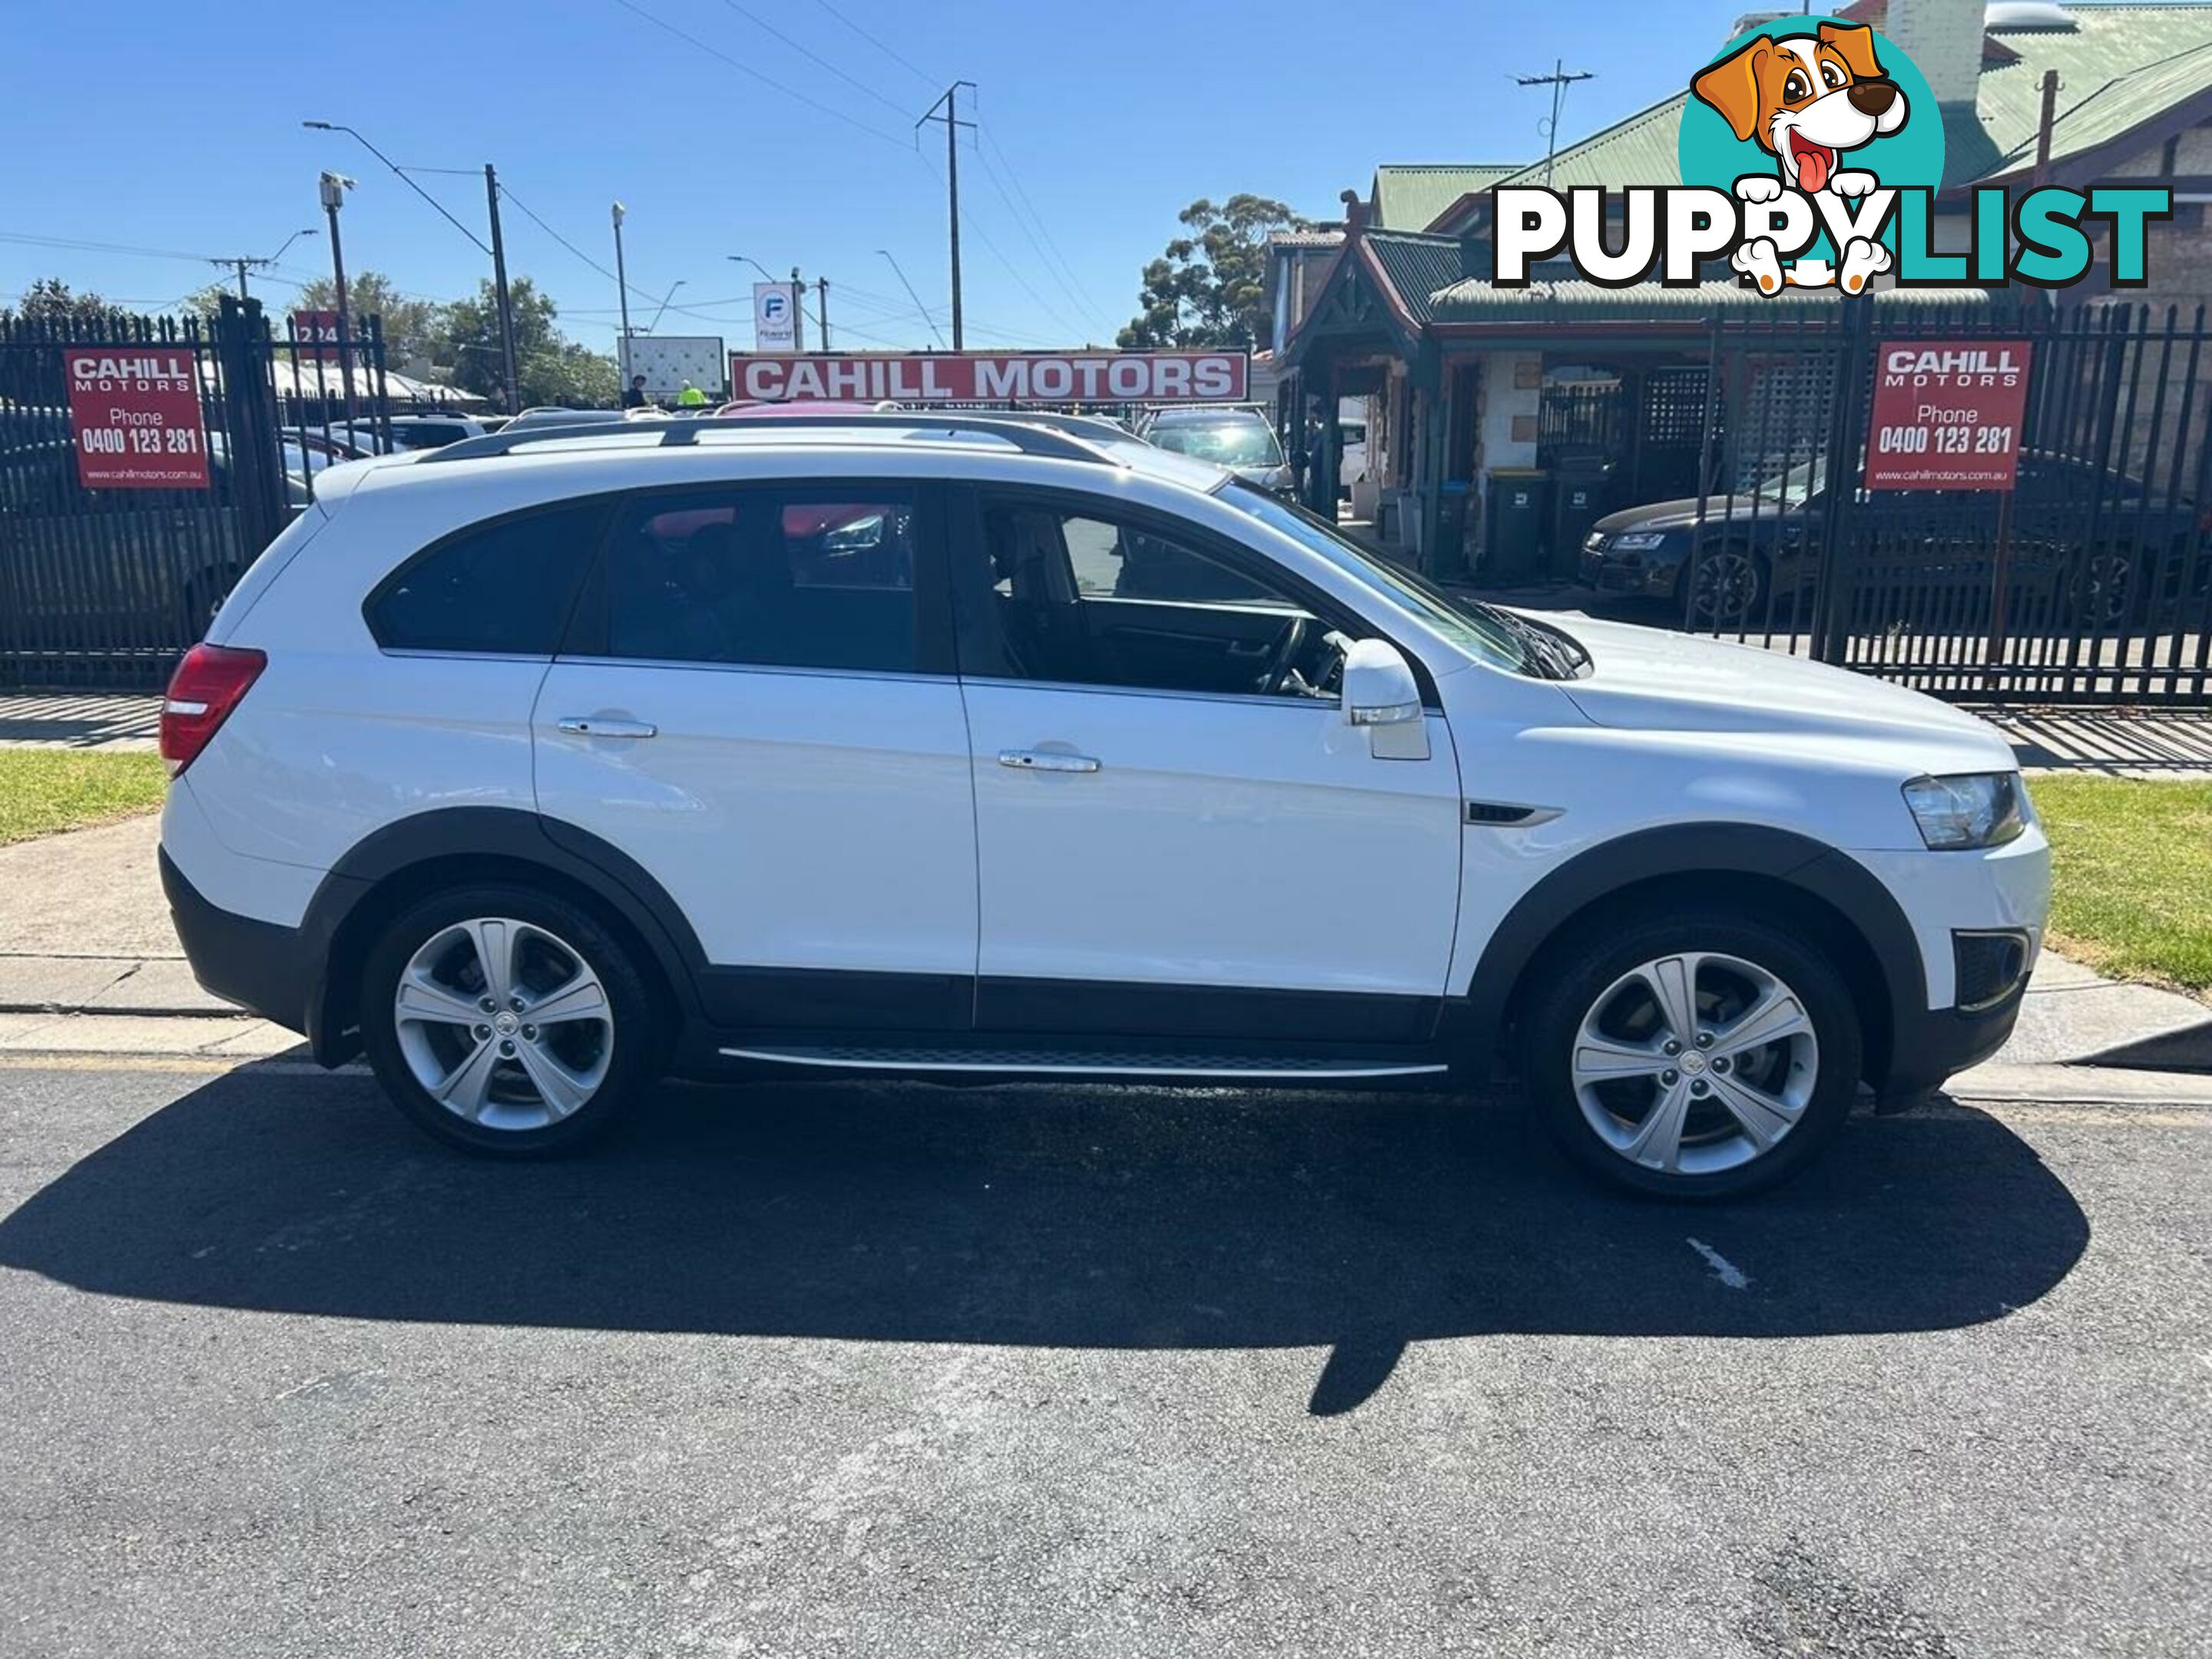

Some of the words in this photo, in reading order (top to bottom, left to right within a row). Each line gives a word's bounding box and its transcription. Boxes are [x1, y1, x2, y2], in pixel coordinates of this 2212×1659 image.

[73, 358, 189, 379] CAHILL
[1887, 350, 2020, 373] CAHILL
[75, 380, 189, 391] MOTORS
[745, 361, 953, 399] CAHILL
[975, 359, 1233, 397] MOTORS
[1885, 374, 2018, 386] MOTORS
[110, 408, 163, 426] Phone
[1918, 405, 1978, 423] Phone
[82, 428, 125, 453] 0400
[129, 428, 161, 453] 123
[166, 428, 197, 453] 281
[1879, 426, 1928, 453] 0400
[1935, 426, 1970, 453] 123
[1975, 426, 2012, 453] 281
[87, 469, 201, 480] www.cahillmotors.com.au
[1875, 469, 2007, 480] www.cahillmotors.com.au
